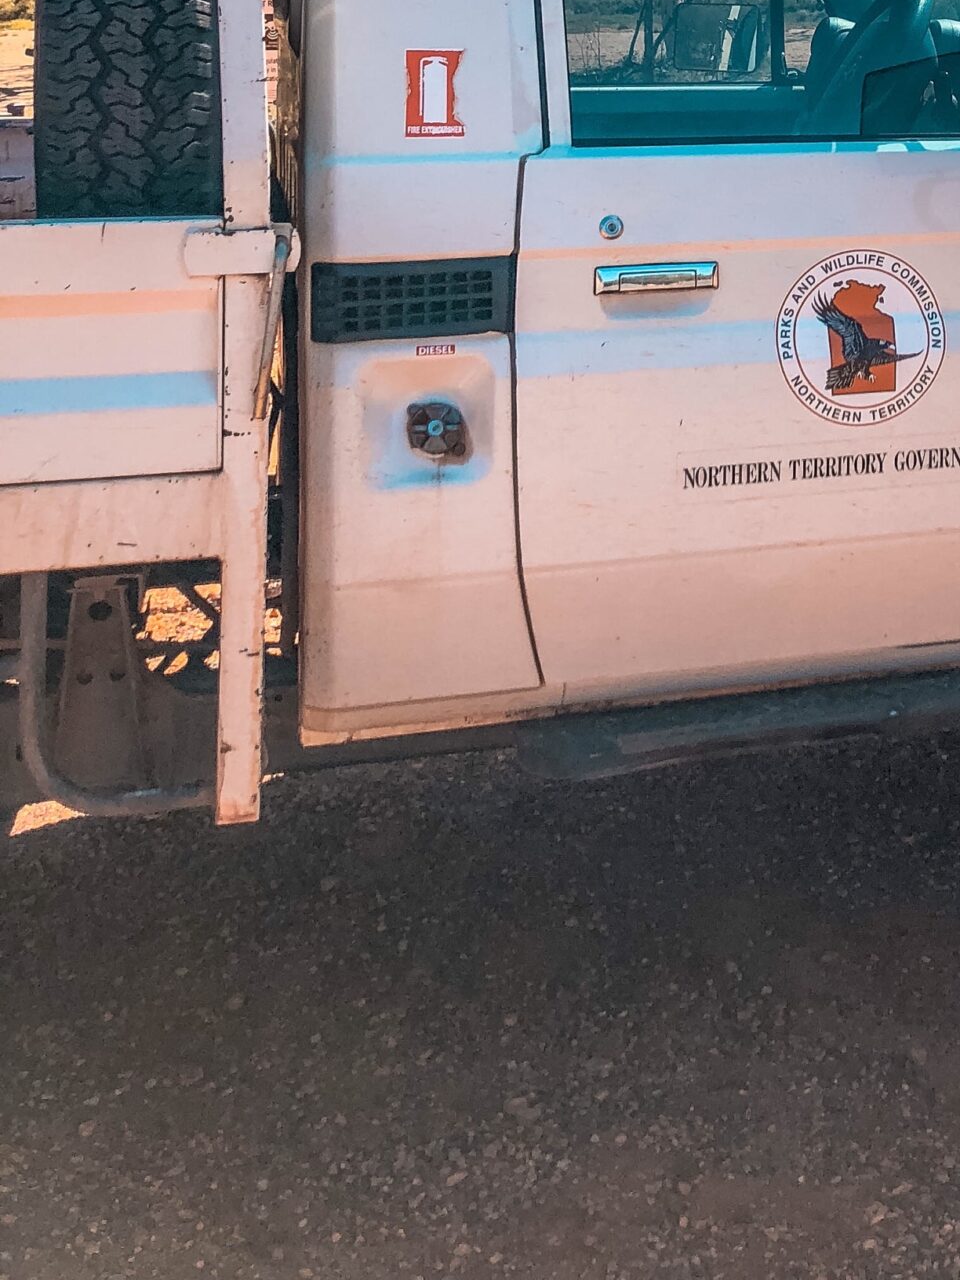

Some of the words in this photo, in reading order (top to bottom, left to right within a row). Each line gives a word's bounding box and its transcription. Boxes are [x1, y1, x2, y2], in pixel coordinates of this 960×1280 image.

[780, 307, 795, 360] PARKS
[791, 274, 816, 304] AND
[820, 253, 886, 275] WILDLIFE
[891, 262, 942, 349] COMMISSION
[418, 345, 454, 355] DIESEL
[790, 375, 862, 423] NORTHERN
[869, 364, 935, 421] TERRITORY
[683, 460, 782, 489] NORTHERN
[788, 452, 888, 481] TERRITORY
